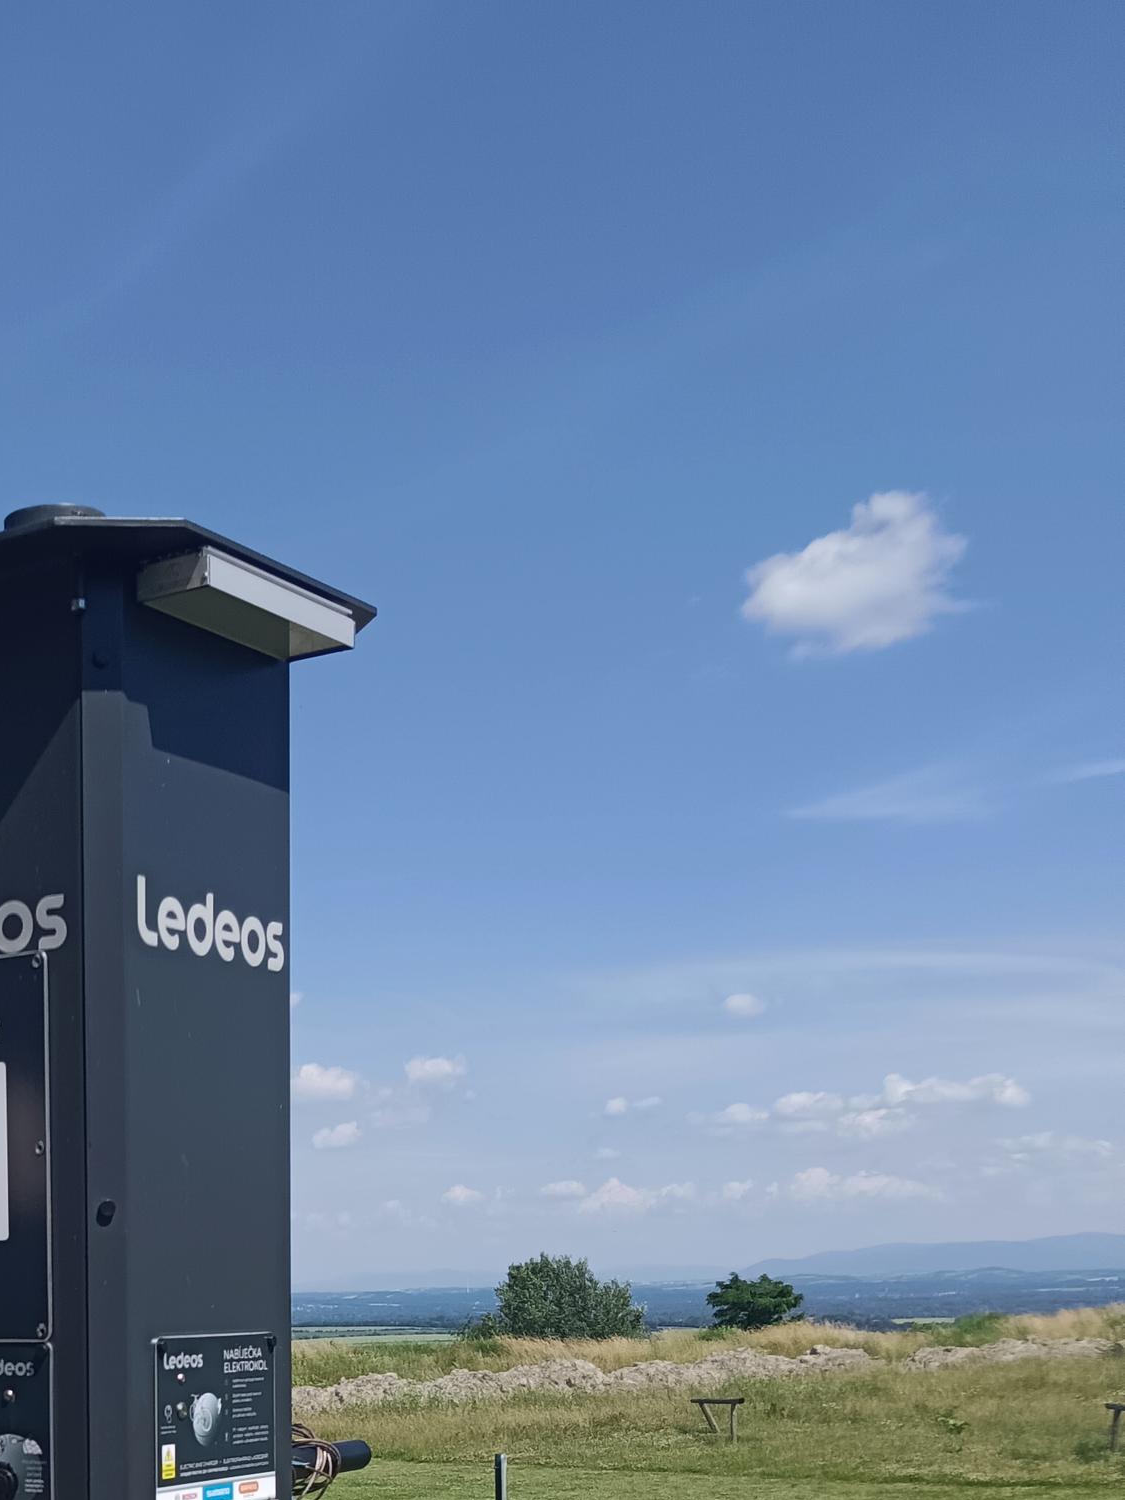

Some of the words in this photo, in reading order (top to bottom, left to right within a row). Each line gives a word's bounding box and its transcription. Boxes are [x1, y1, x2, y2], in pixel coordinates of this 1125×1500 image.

[136, 874, 285, 972] Ledeos
[163, 1352, 203, 1370] Ledeos
[223, 1345, 262, 1361] NABÍJEČKA
[223, 1359, 268, 1374] ELEKTROKOL
